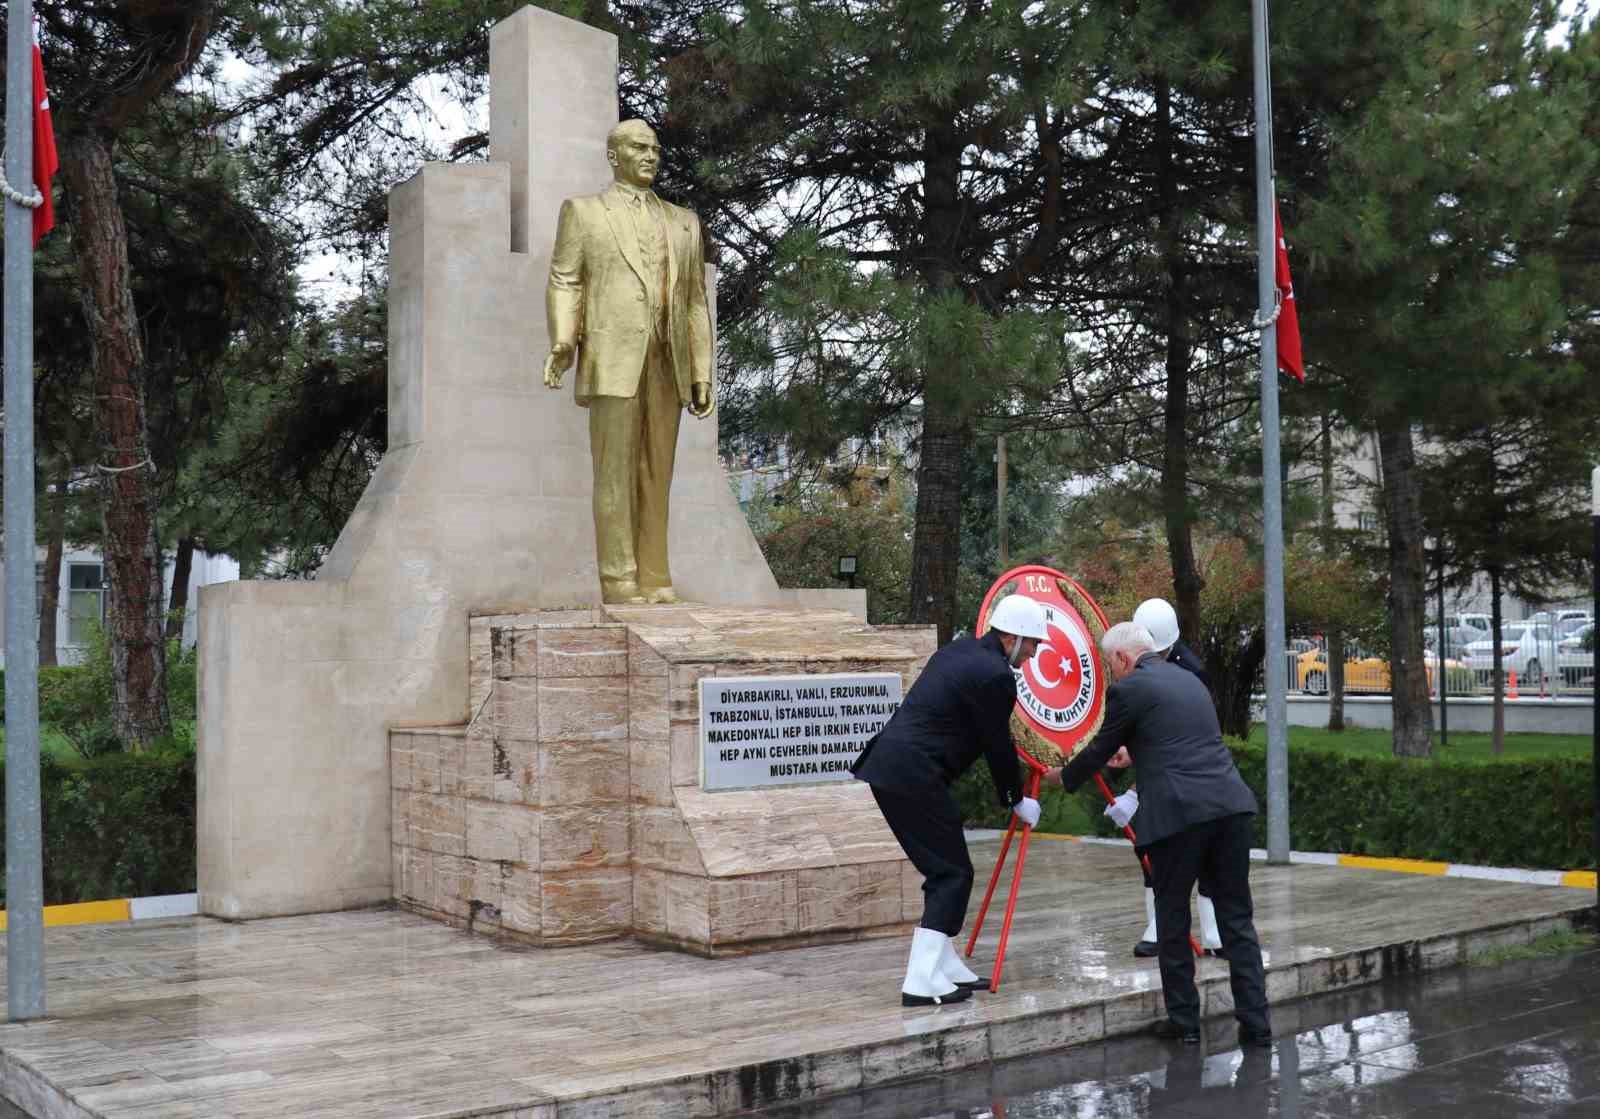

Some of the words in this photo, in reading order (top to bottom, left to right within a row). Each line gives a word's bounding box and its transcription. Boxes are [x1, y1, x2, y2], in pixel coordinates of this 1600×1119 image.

[1025, 575, 1052, 593] T.C.
[721, 688, 793, 704] DİYARBAKIRLI,
[796, 687, 828, 701] VANLI,
[831, 684, 889, 699] ERZURUMLU,
[1013, 671, 1052, 721] AHALLE
[1055, 653, 1092, 723] MUHTARLARI
[710, 709, 773, 724] TRABZONLU,
[776, 705, 838, 719] İSTANBULLU,
[841, 703, 885, 717] TRAKYALI
[708, 728, 779, 744] MAKEDONYALI
[783, 726, 801, 738] HEP
[805, 722, 821, 737] BİR
[824, 723, 850, 737] IRKIN
[720, 748, 739, 762] HEP
[743, 747, 766, 760] AYNI
[770, 742, 818, 759] CEVHERİN
[821, 740, 867, 755] DAMARLA
[770, 762, 818, 777] MUSTAFA
[821, 759, 854, 773] KEMAL
